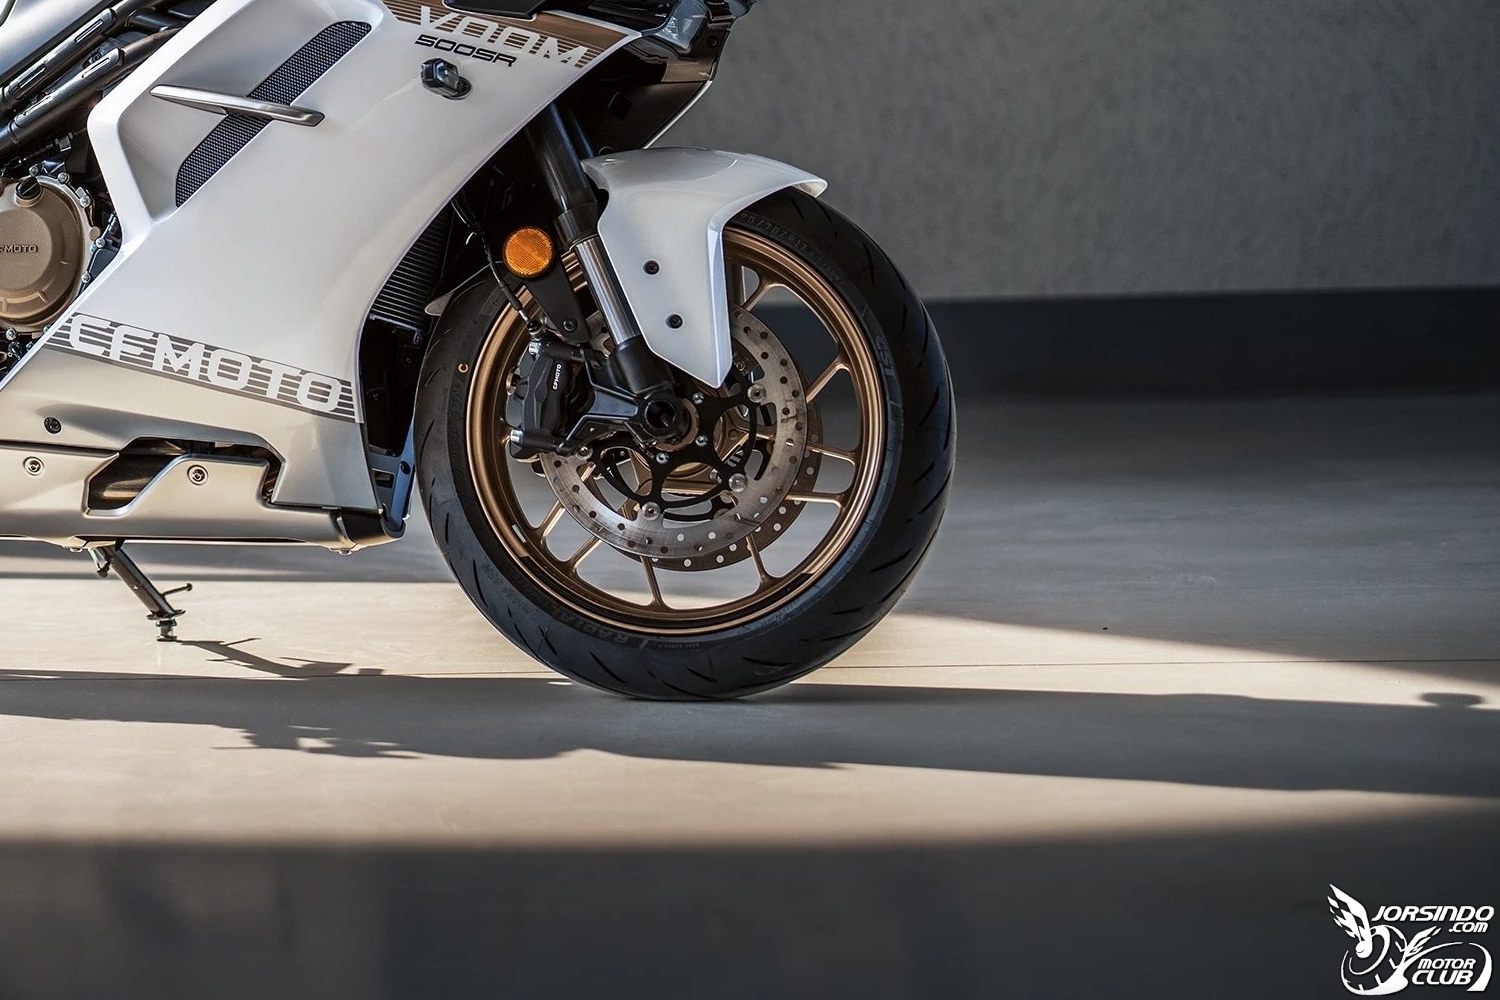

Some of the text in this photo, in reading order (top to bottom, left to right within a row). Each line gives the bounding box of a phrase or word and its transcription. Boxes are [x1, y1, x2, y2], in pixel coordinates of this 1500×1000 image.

[415, 34, 517, 67] 500SR
[421, 5, 589, 67] VOOM
[69, 314, 342, 412] CFMOTO
[552, 363, 562, 390] CFMOTO
